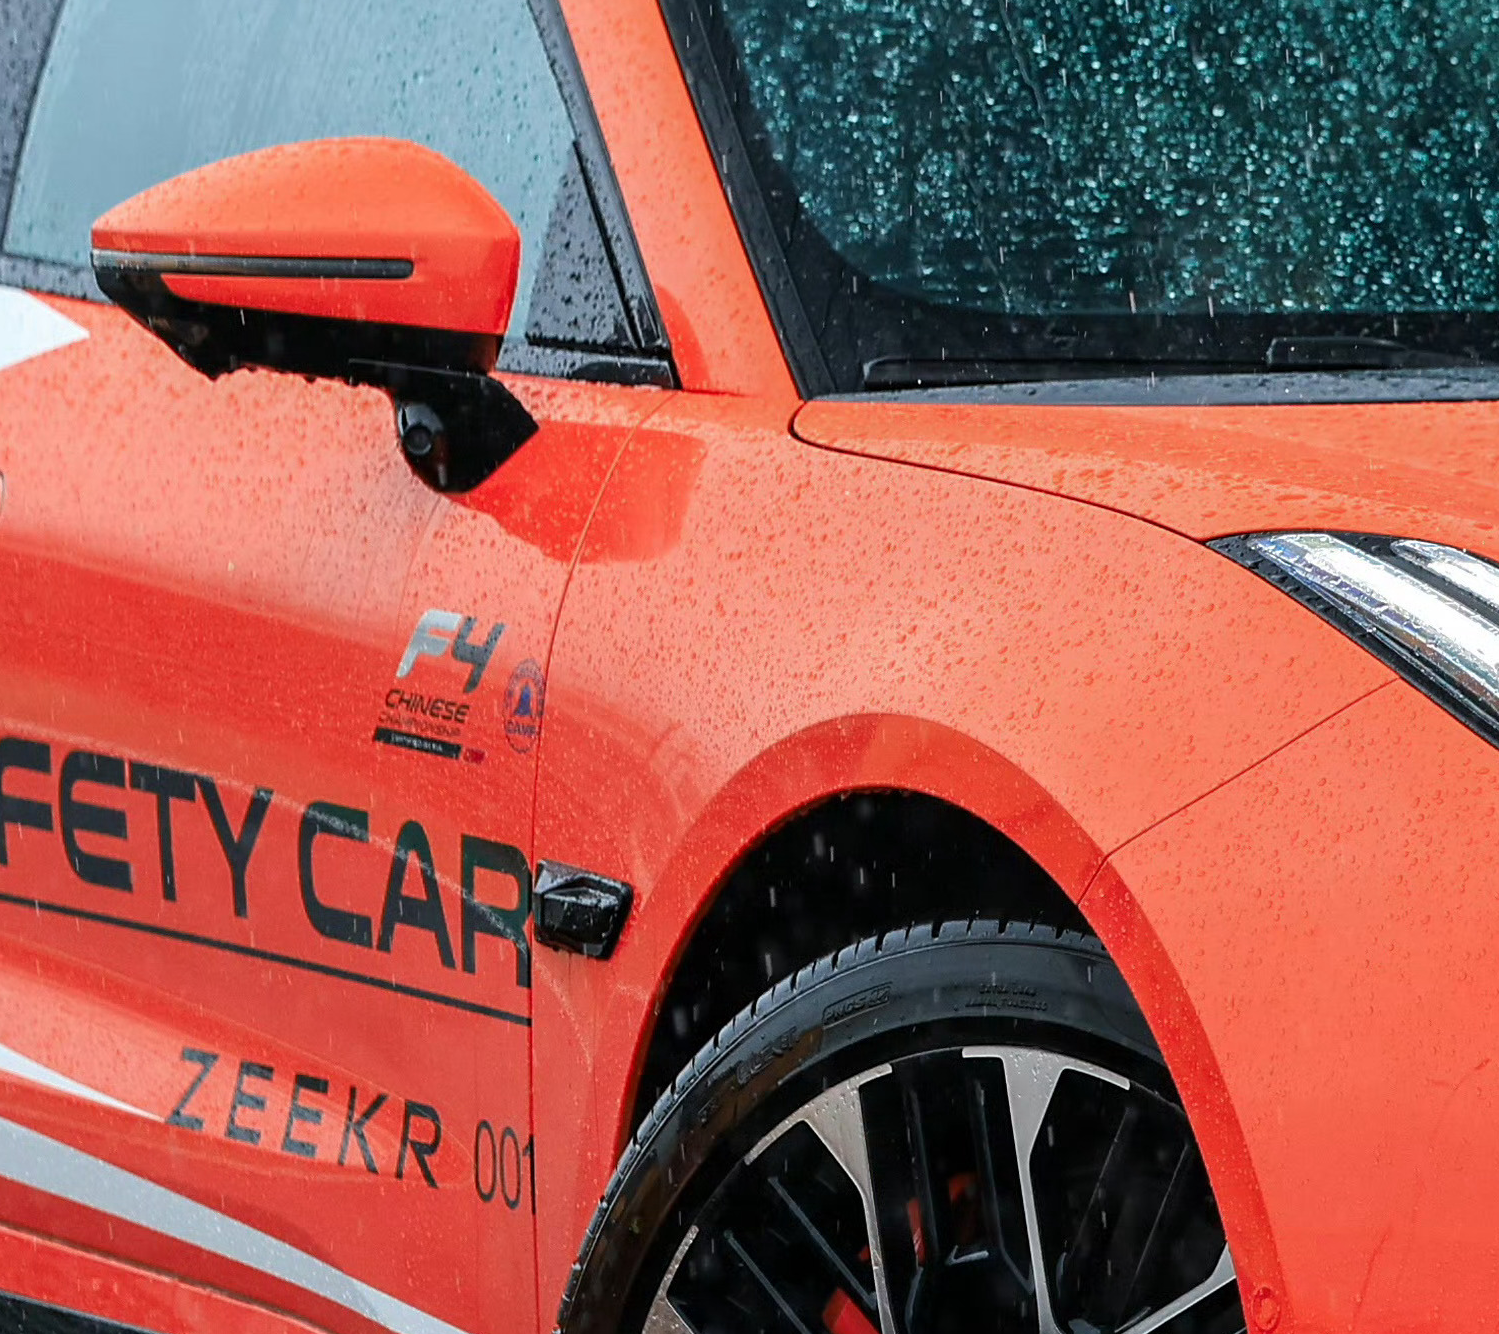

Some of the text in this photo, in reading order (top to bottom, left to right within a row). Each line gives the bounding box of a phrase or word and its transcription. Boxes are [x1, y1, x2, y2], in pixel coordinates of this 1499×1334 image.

[384, 688, 470, 724] CHINESE
[395, 608, 506, 694] F4
[299, 801, 533, 989] CAR
[166, 1049, 535, 1215] ZEEKR 001
